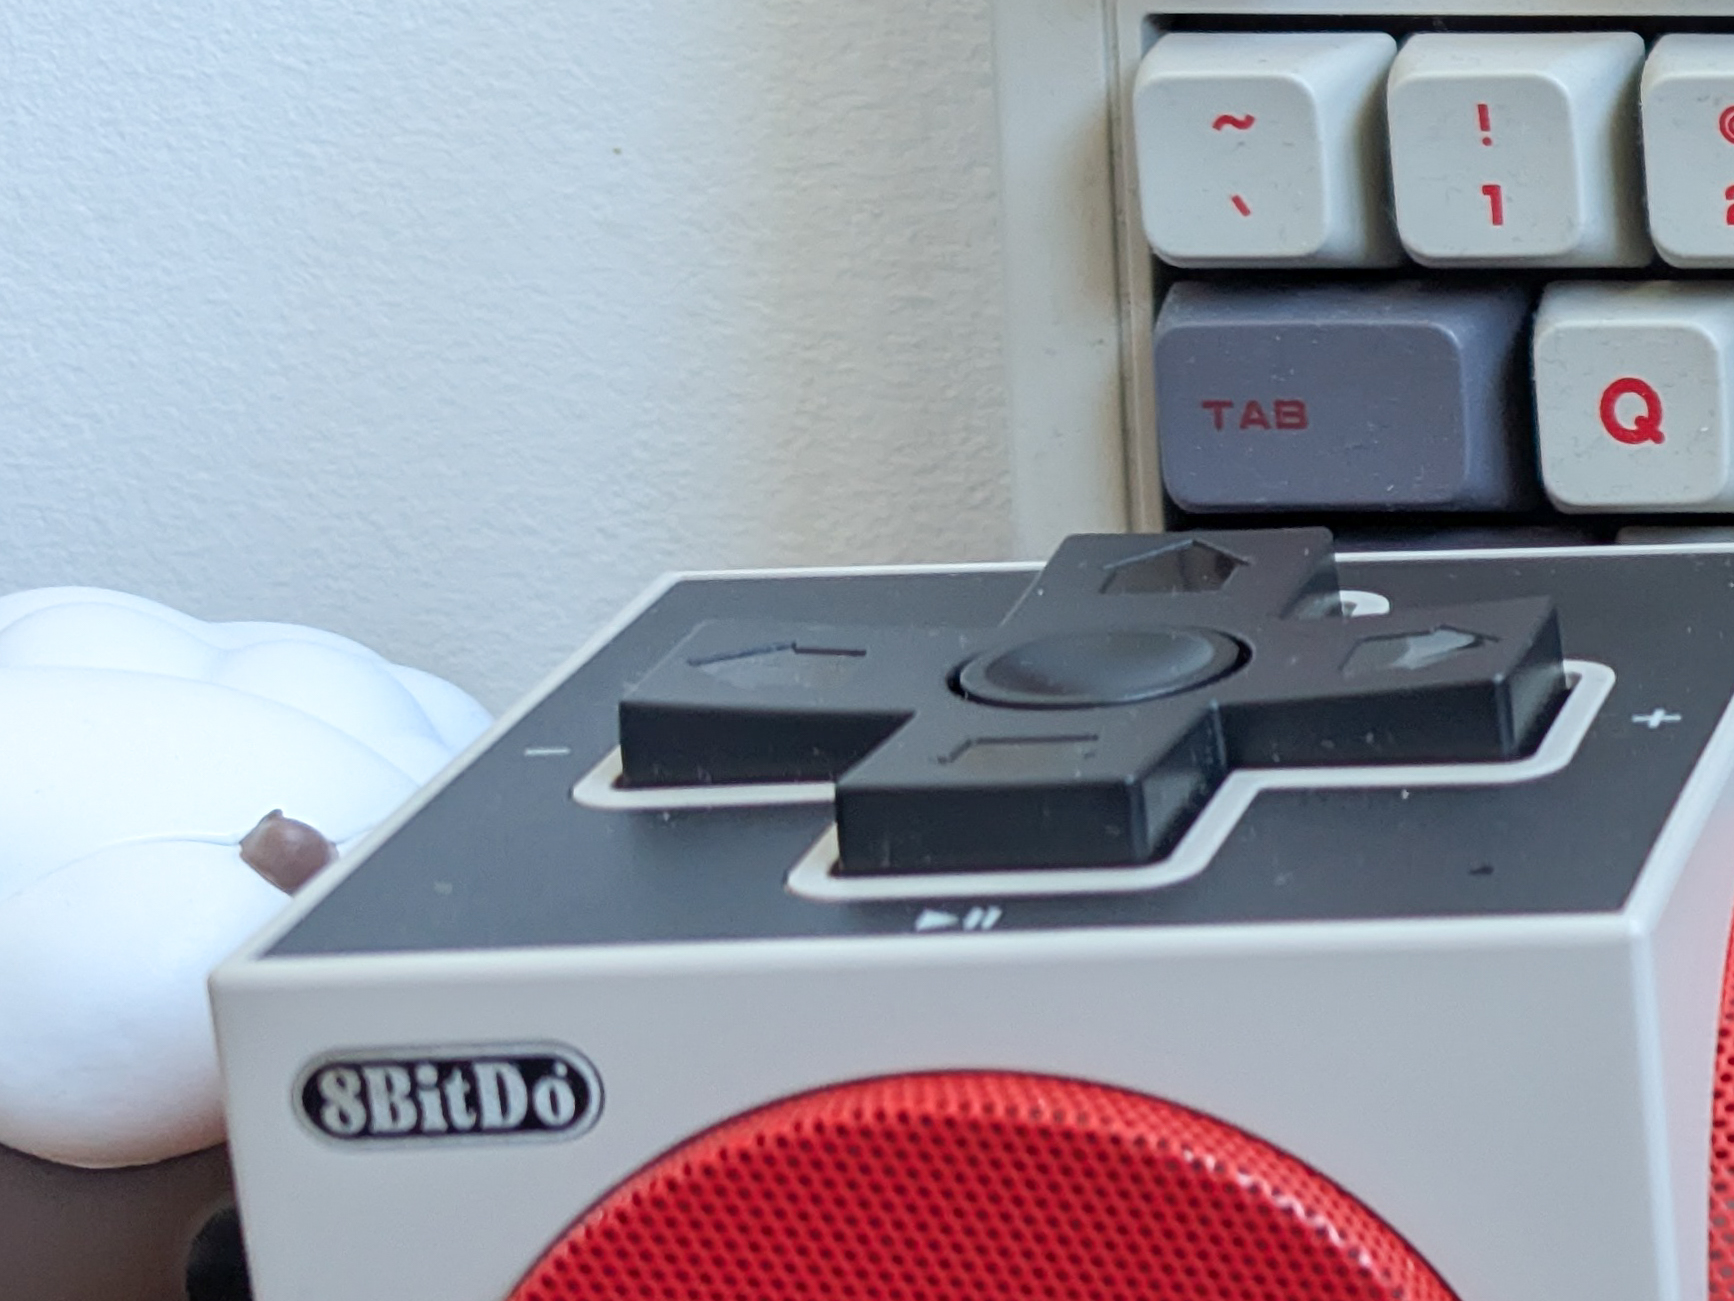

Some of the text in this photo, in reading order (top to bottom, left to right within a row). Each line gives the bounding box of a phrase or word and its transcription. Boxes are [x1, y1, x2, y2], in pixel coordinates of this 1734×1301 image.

[1478, 104, 1491, 145] !
[1481, 184, 1503, 225] 1
[1202, 398, 1309, 430] TAB
[1599, 378, 1664, 444] Q
[317, 1060, 576, 1135] 8BitDo
